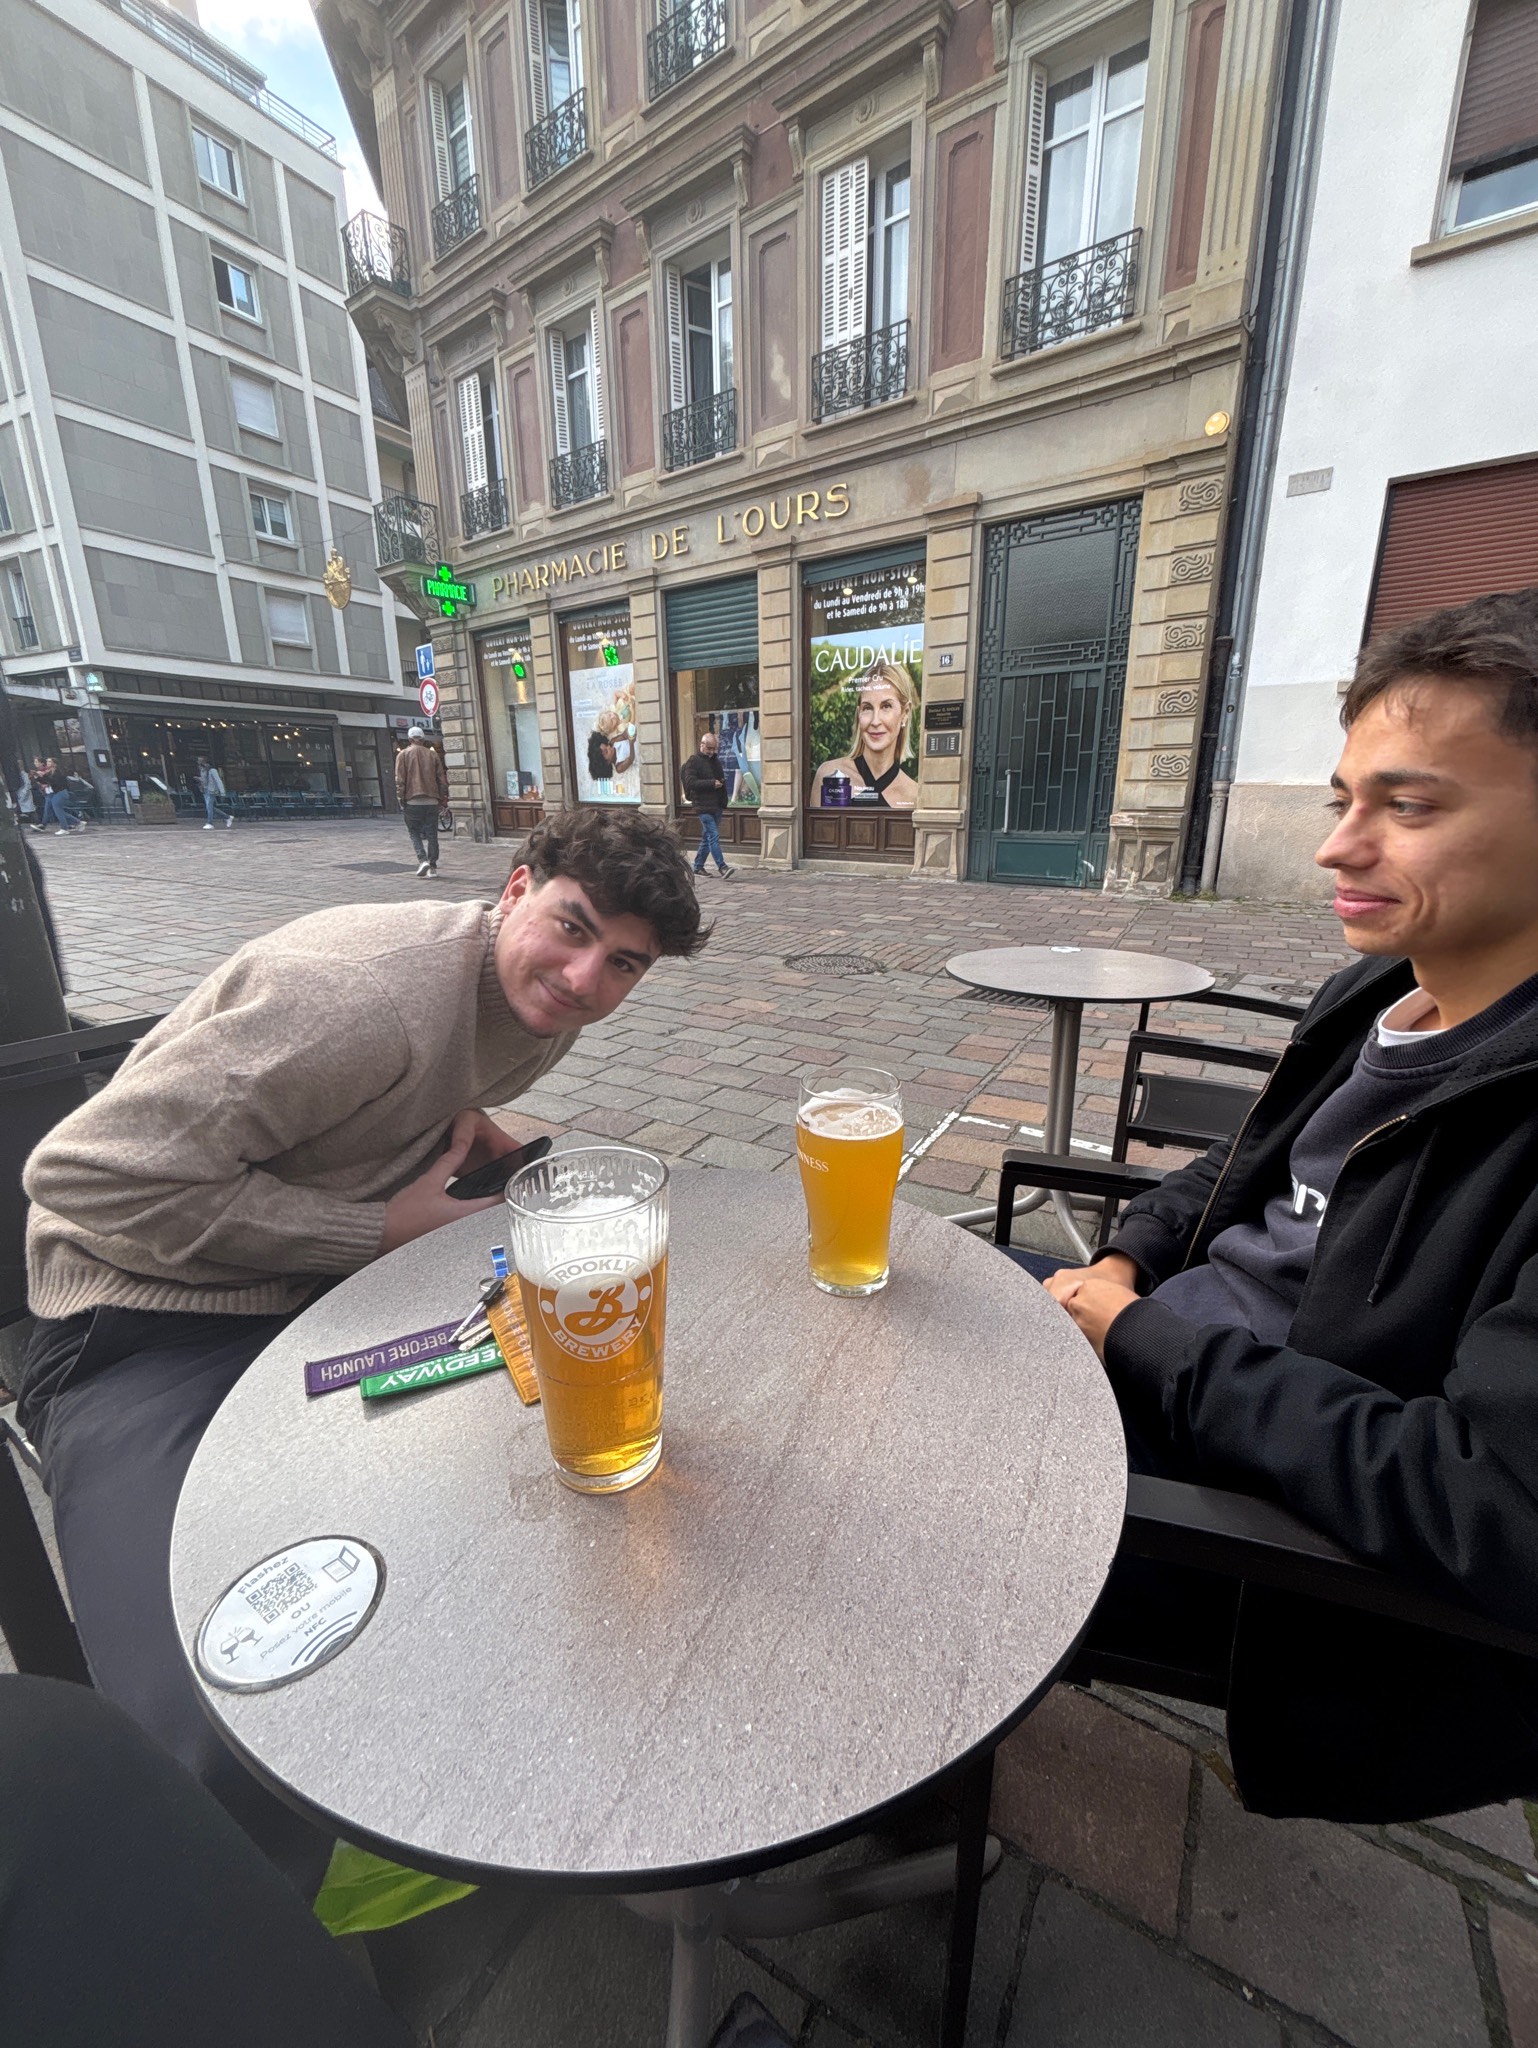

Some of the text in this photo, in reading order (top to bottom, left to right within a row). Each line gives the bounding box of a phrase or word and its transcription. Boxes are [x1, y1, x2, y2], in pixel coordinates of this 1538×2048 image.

[492, 482, 850, 600] PHARMACIE DE L'OURS
[862, 564, 918, 585] NON-STOP
[426, 579, 468, 601] PHARMACIE
[813, 599, 822, 610] du
[823, 596, 841, 608] Lundi
[842, 597, 850, 605] au
[851, 590, 882, 604] Vendredi
[883, 588, 892, 598] de
[894, 585, 903, 596] 9h
[904, 586, 910, 595] à
[826, 599, 909, 620] et le Samedi de 9h à 18h
[941, 655, 950, 665] 16
[848, 674, 884, 684] Premier Cru
[553, 1314, 642, 1359] BREWERY
[320, 1332, 449, 1383] BEFORE LAUNCH
[237, 1556, 289, 1595] Flashez
[291, 1602, 311, 1620] OU
[259, 1587, 353, 1660] Posez votre mobile
[303, 1617, 327, 1637] NFC
